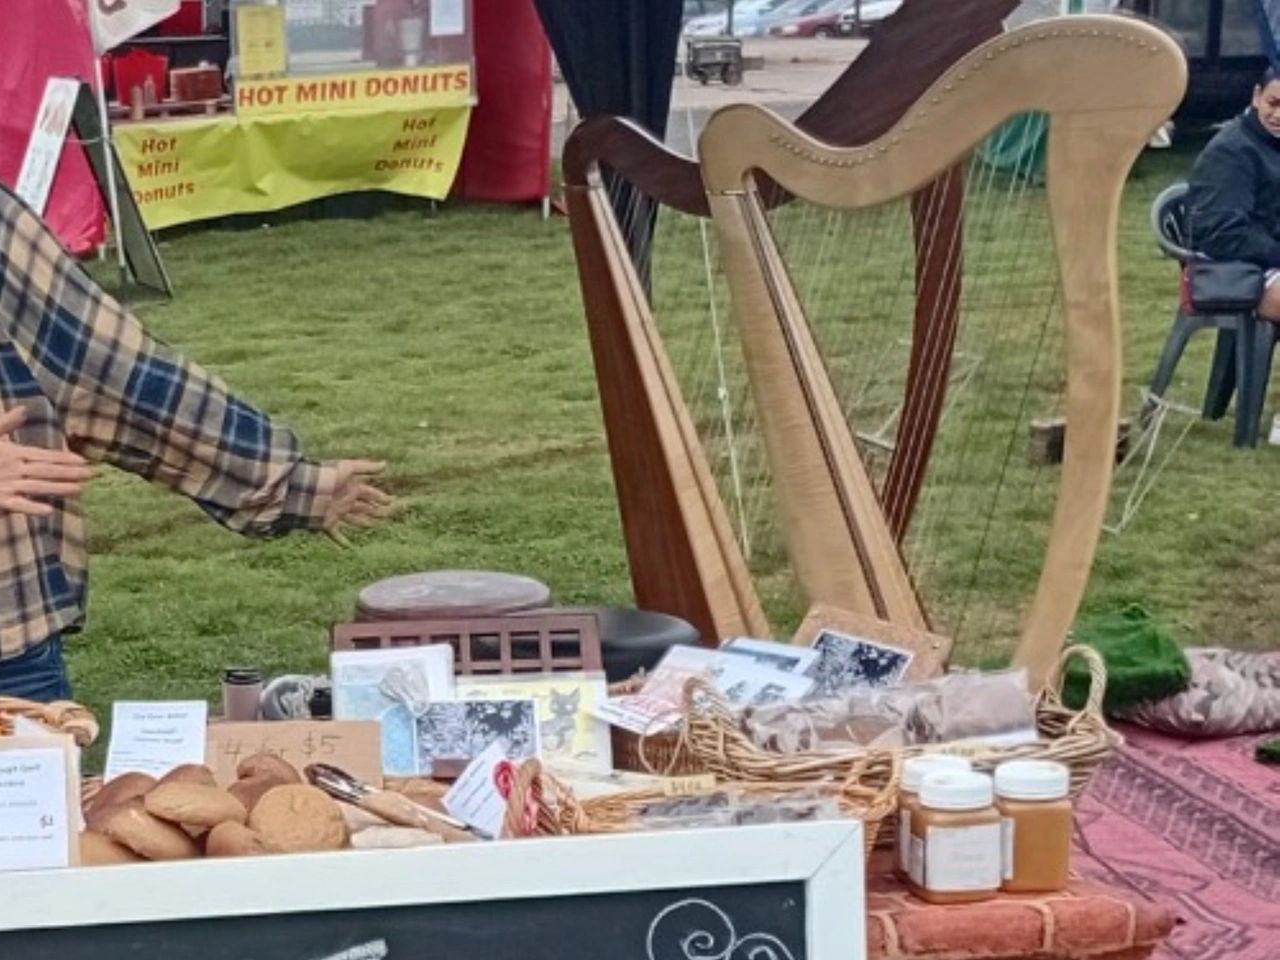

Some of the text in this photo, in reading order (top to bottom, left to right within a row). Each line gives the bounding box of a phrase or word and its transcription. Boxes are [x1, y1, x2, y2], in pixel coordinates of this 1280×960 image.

[238, 70, 470, 108] HOT MINI DONUTS
[401, 115, 437, 133] Hot
[140, 136, 177, 154] Hot
[391, 134, 437, 152] Mini
[136, 158, 180, 179] Mini
[372, 155, 444, 175] Donuts
[132, 179, 195, 206] Donuts
[224, 738, 244, 762] 4
[300, 731, 342, 759] $5
